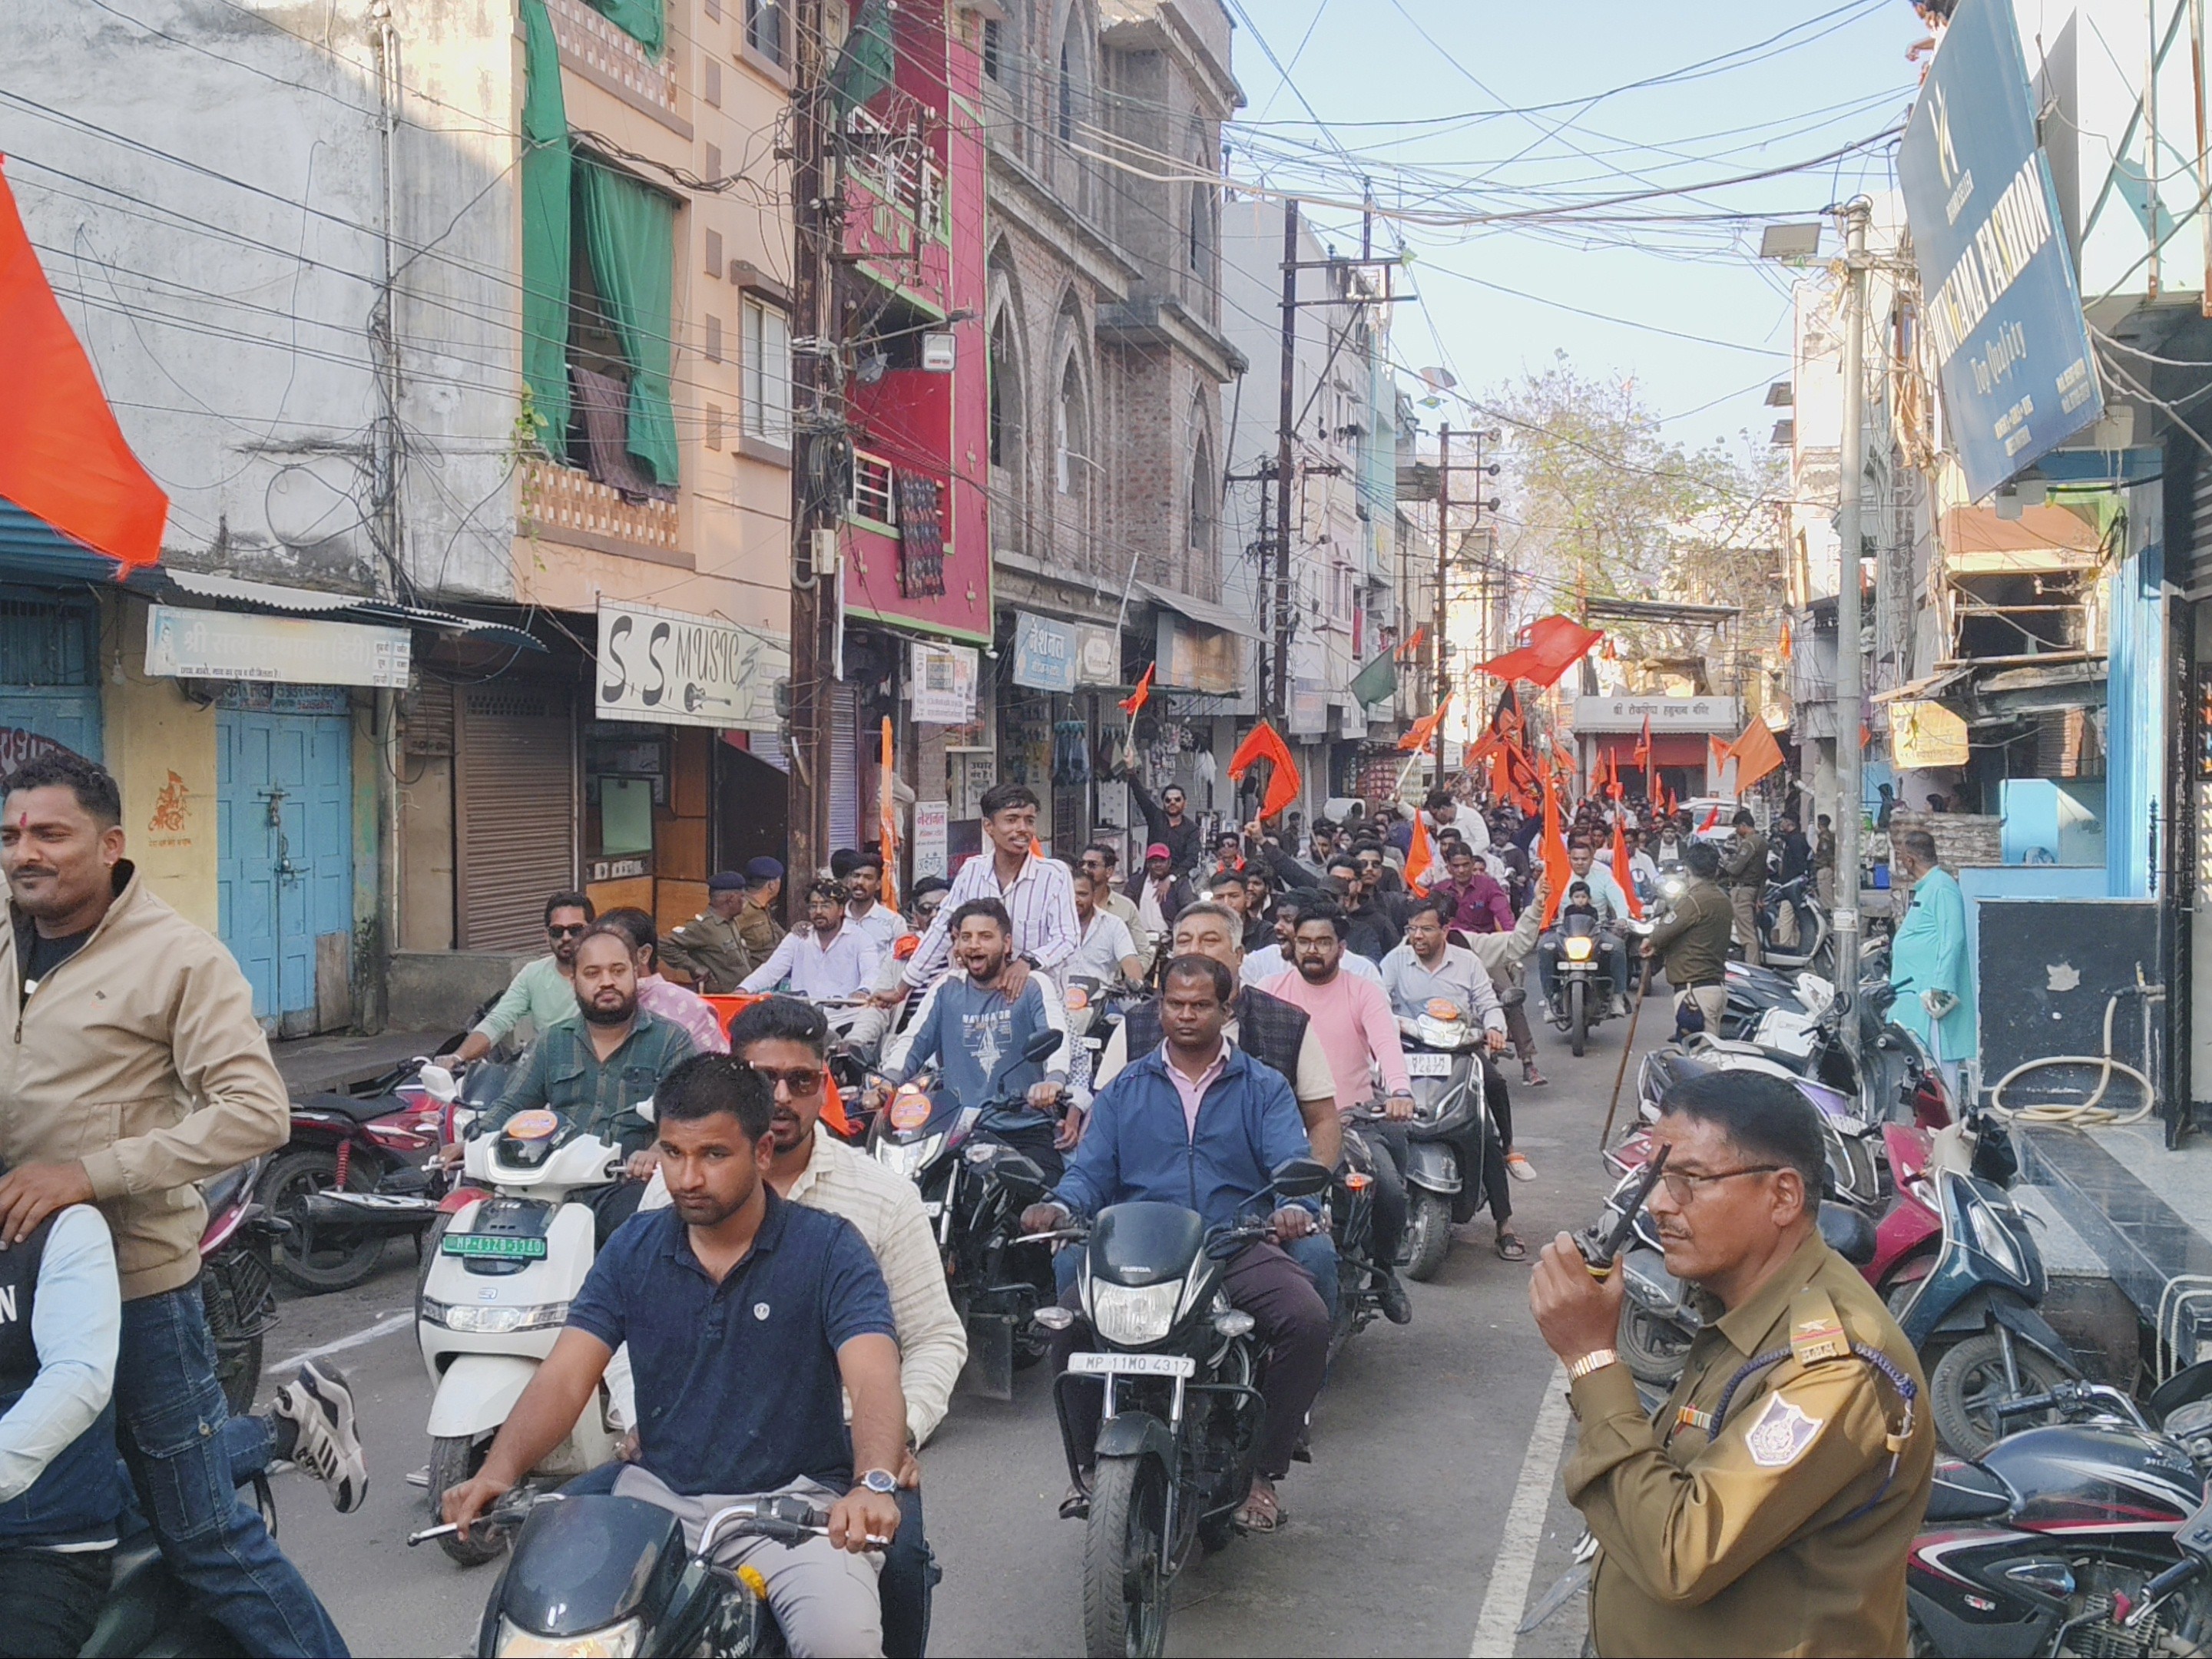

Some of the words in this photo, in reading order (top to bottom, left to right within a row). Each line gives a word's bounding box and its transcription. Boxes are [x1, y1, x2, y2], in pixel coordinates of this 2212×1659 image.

[1928, 243, 1989, 368] HUNGAMA
[1975, 151, 2051, 304] FASHION
[1986, 320, 2028, 384] Quality
[184, 621, 207, 653] श्री
[676, 625, 739, 685] MUSIC
[1028, 616, 1065, 660] नेशनल
